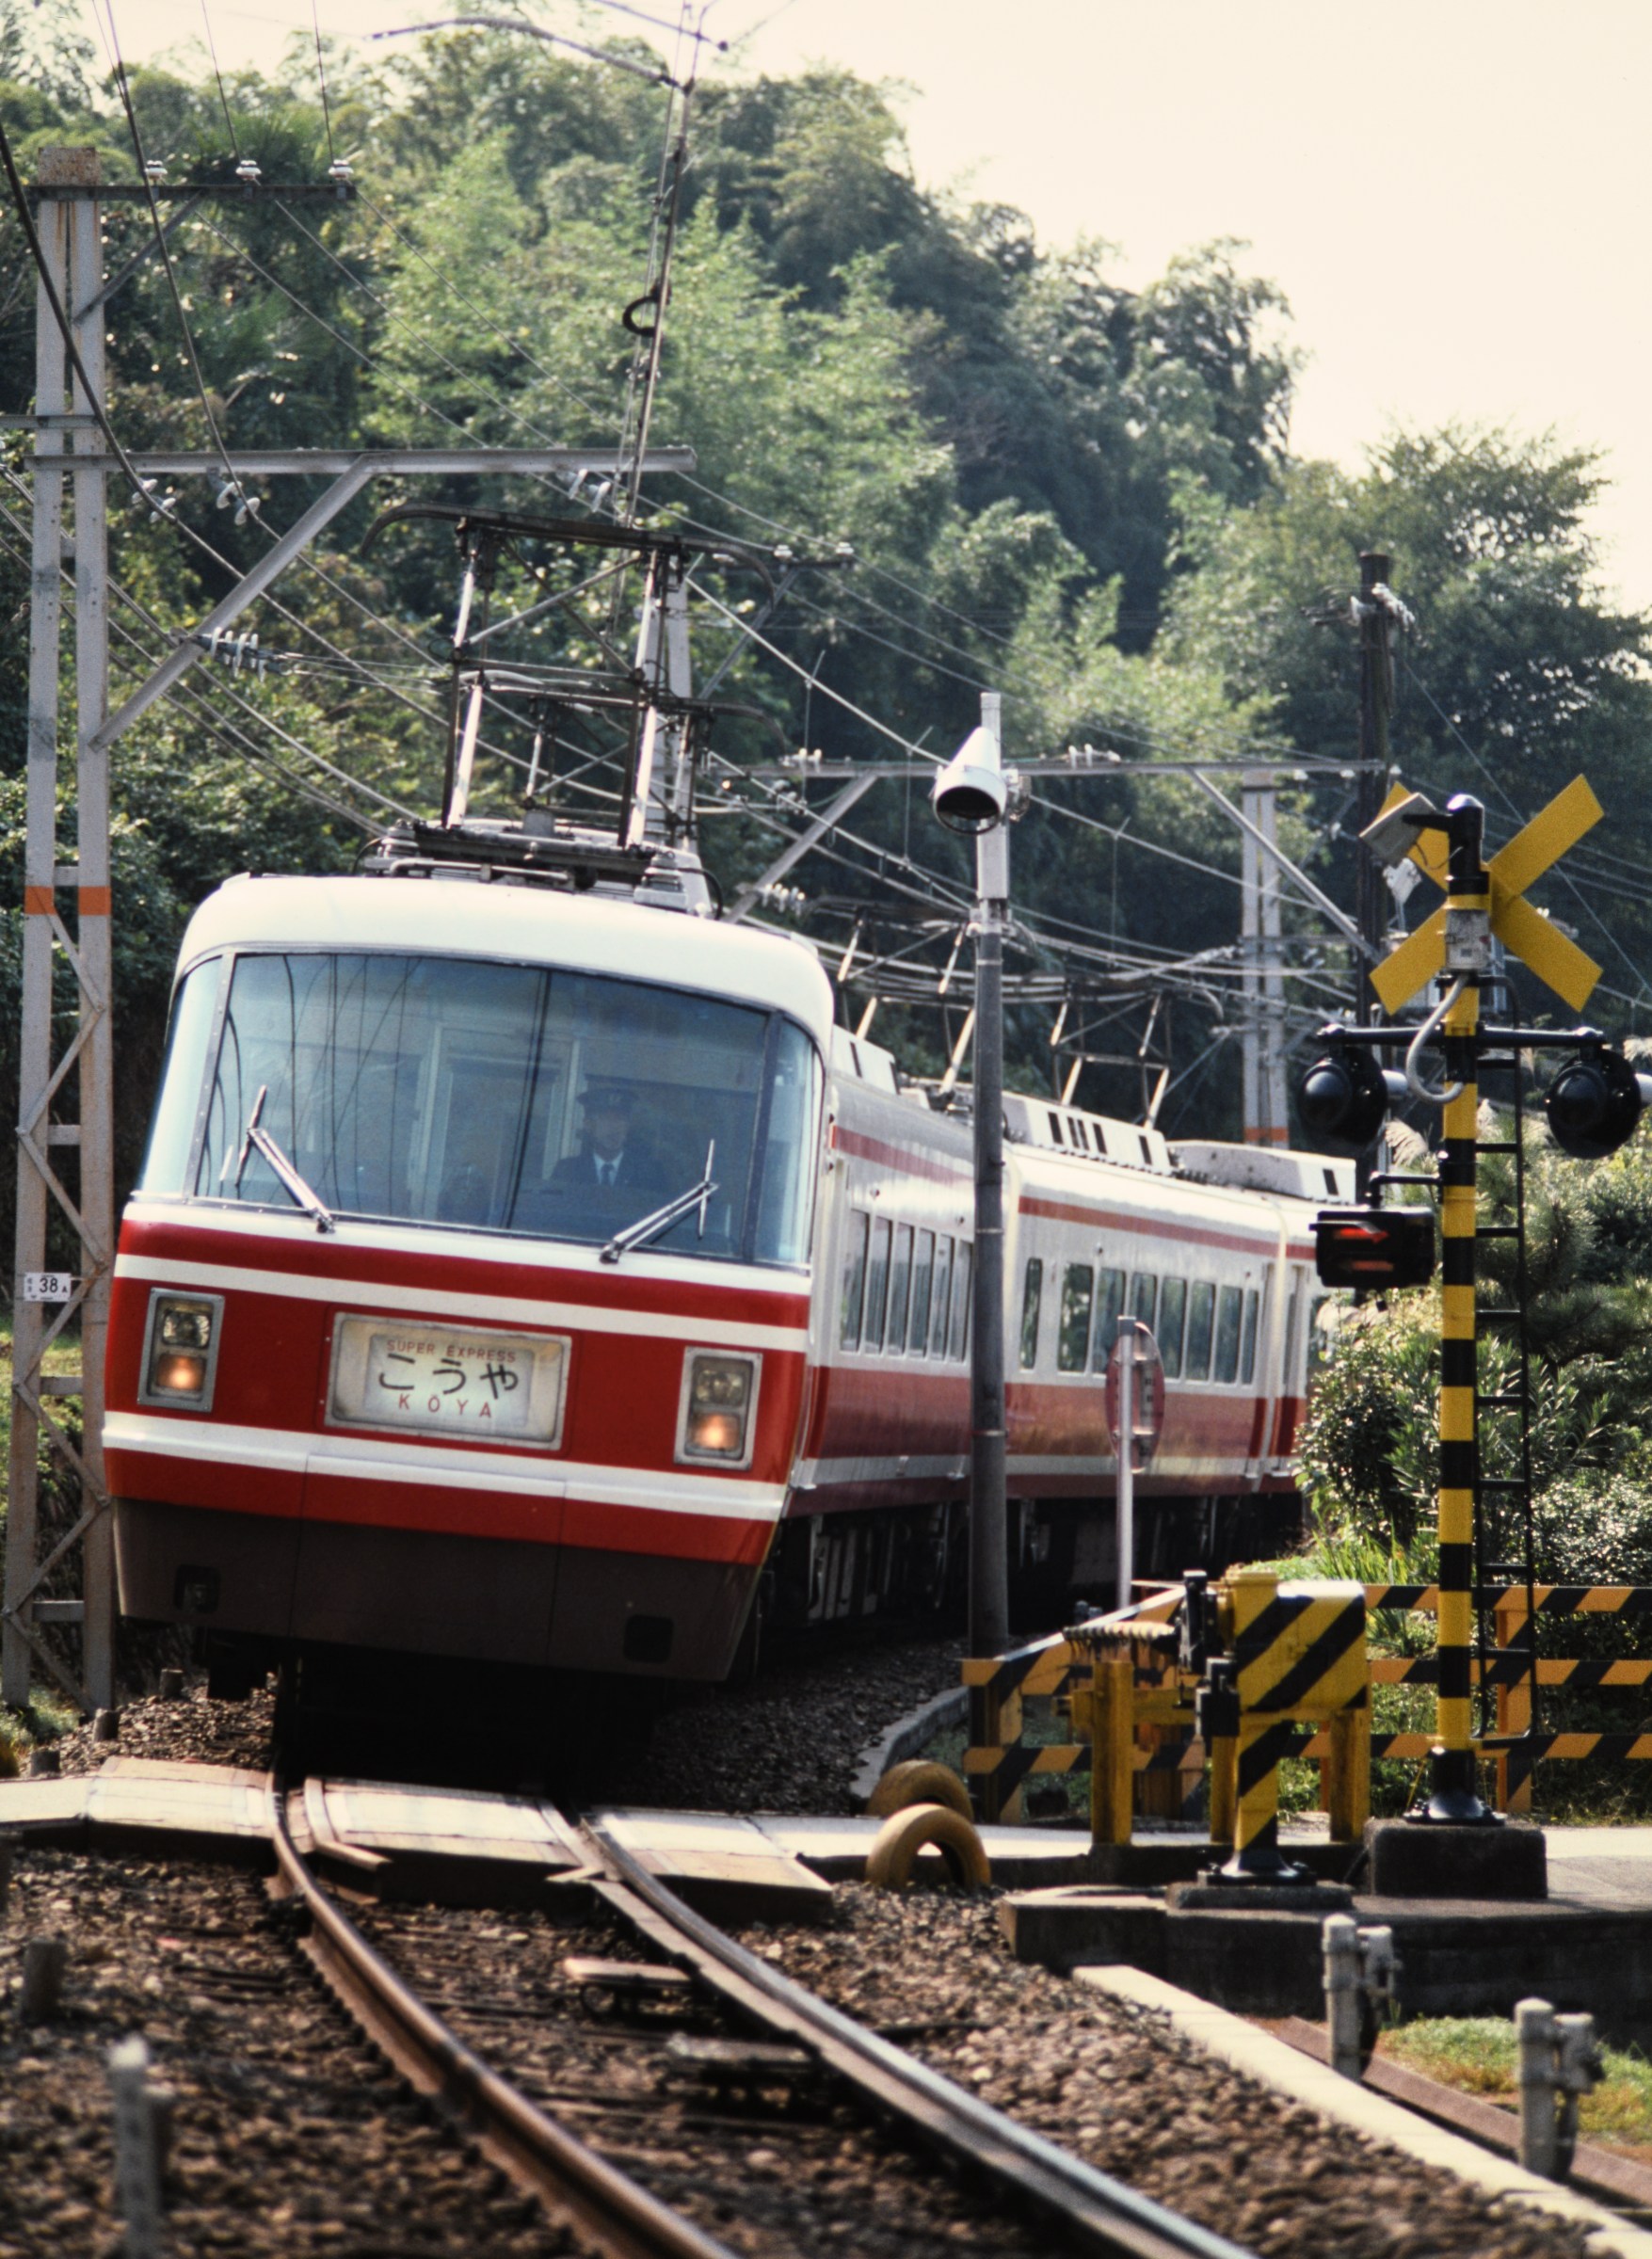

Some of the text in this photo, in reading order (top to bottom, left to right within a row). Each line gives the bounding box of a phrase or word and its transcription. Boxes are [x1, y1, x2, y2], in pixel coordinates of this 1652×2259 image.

[40, 1277, 58, 1293] 38
[386, 1339, 517, 1363] SUPER EXPRESS
[378, 1353, 519, 1400] こうや
